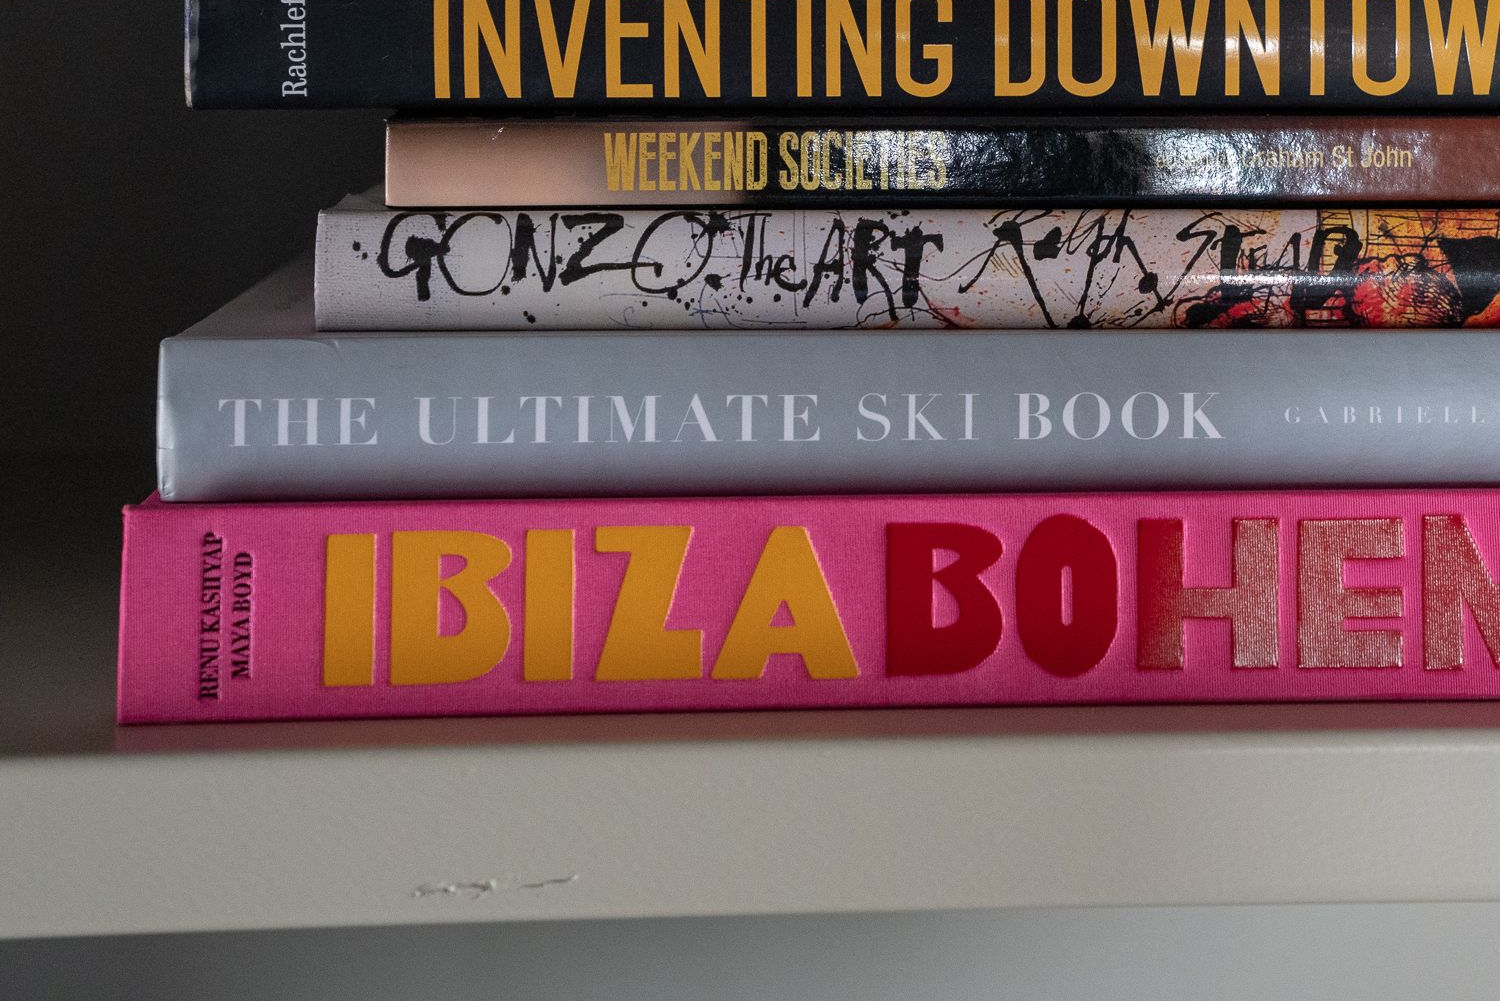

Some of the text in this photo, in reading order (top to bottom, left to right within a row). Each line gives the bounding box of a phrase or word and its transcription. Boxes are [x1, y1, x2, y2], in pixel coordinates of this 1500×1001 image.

[603, 130, 948, 192] WEEKEND SOCIETIES
[1331, 144, 1354, 169] St
[1360, 145, 1413, 169] John
[377, 210, 713, 301] GONZO
[802, 216, 944, 322] ART
[218, 391, 1226, 448] THE ULTIMATE SKI BOOK
[200, 531, 223, 700] RENU KASHYAP
[231, 551, 253, 680] MAYA BOYD
[323, 525, 862, 687] IBIZA
